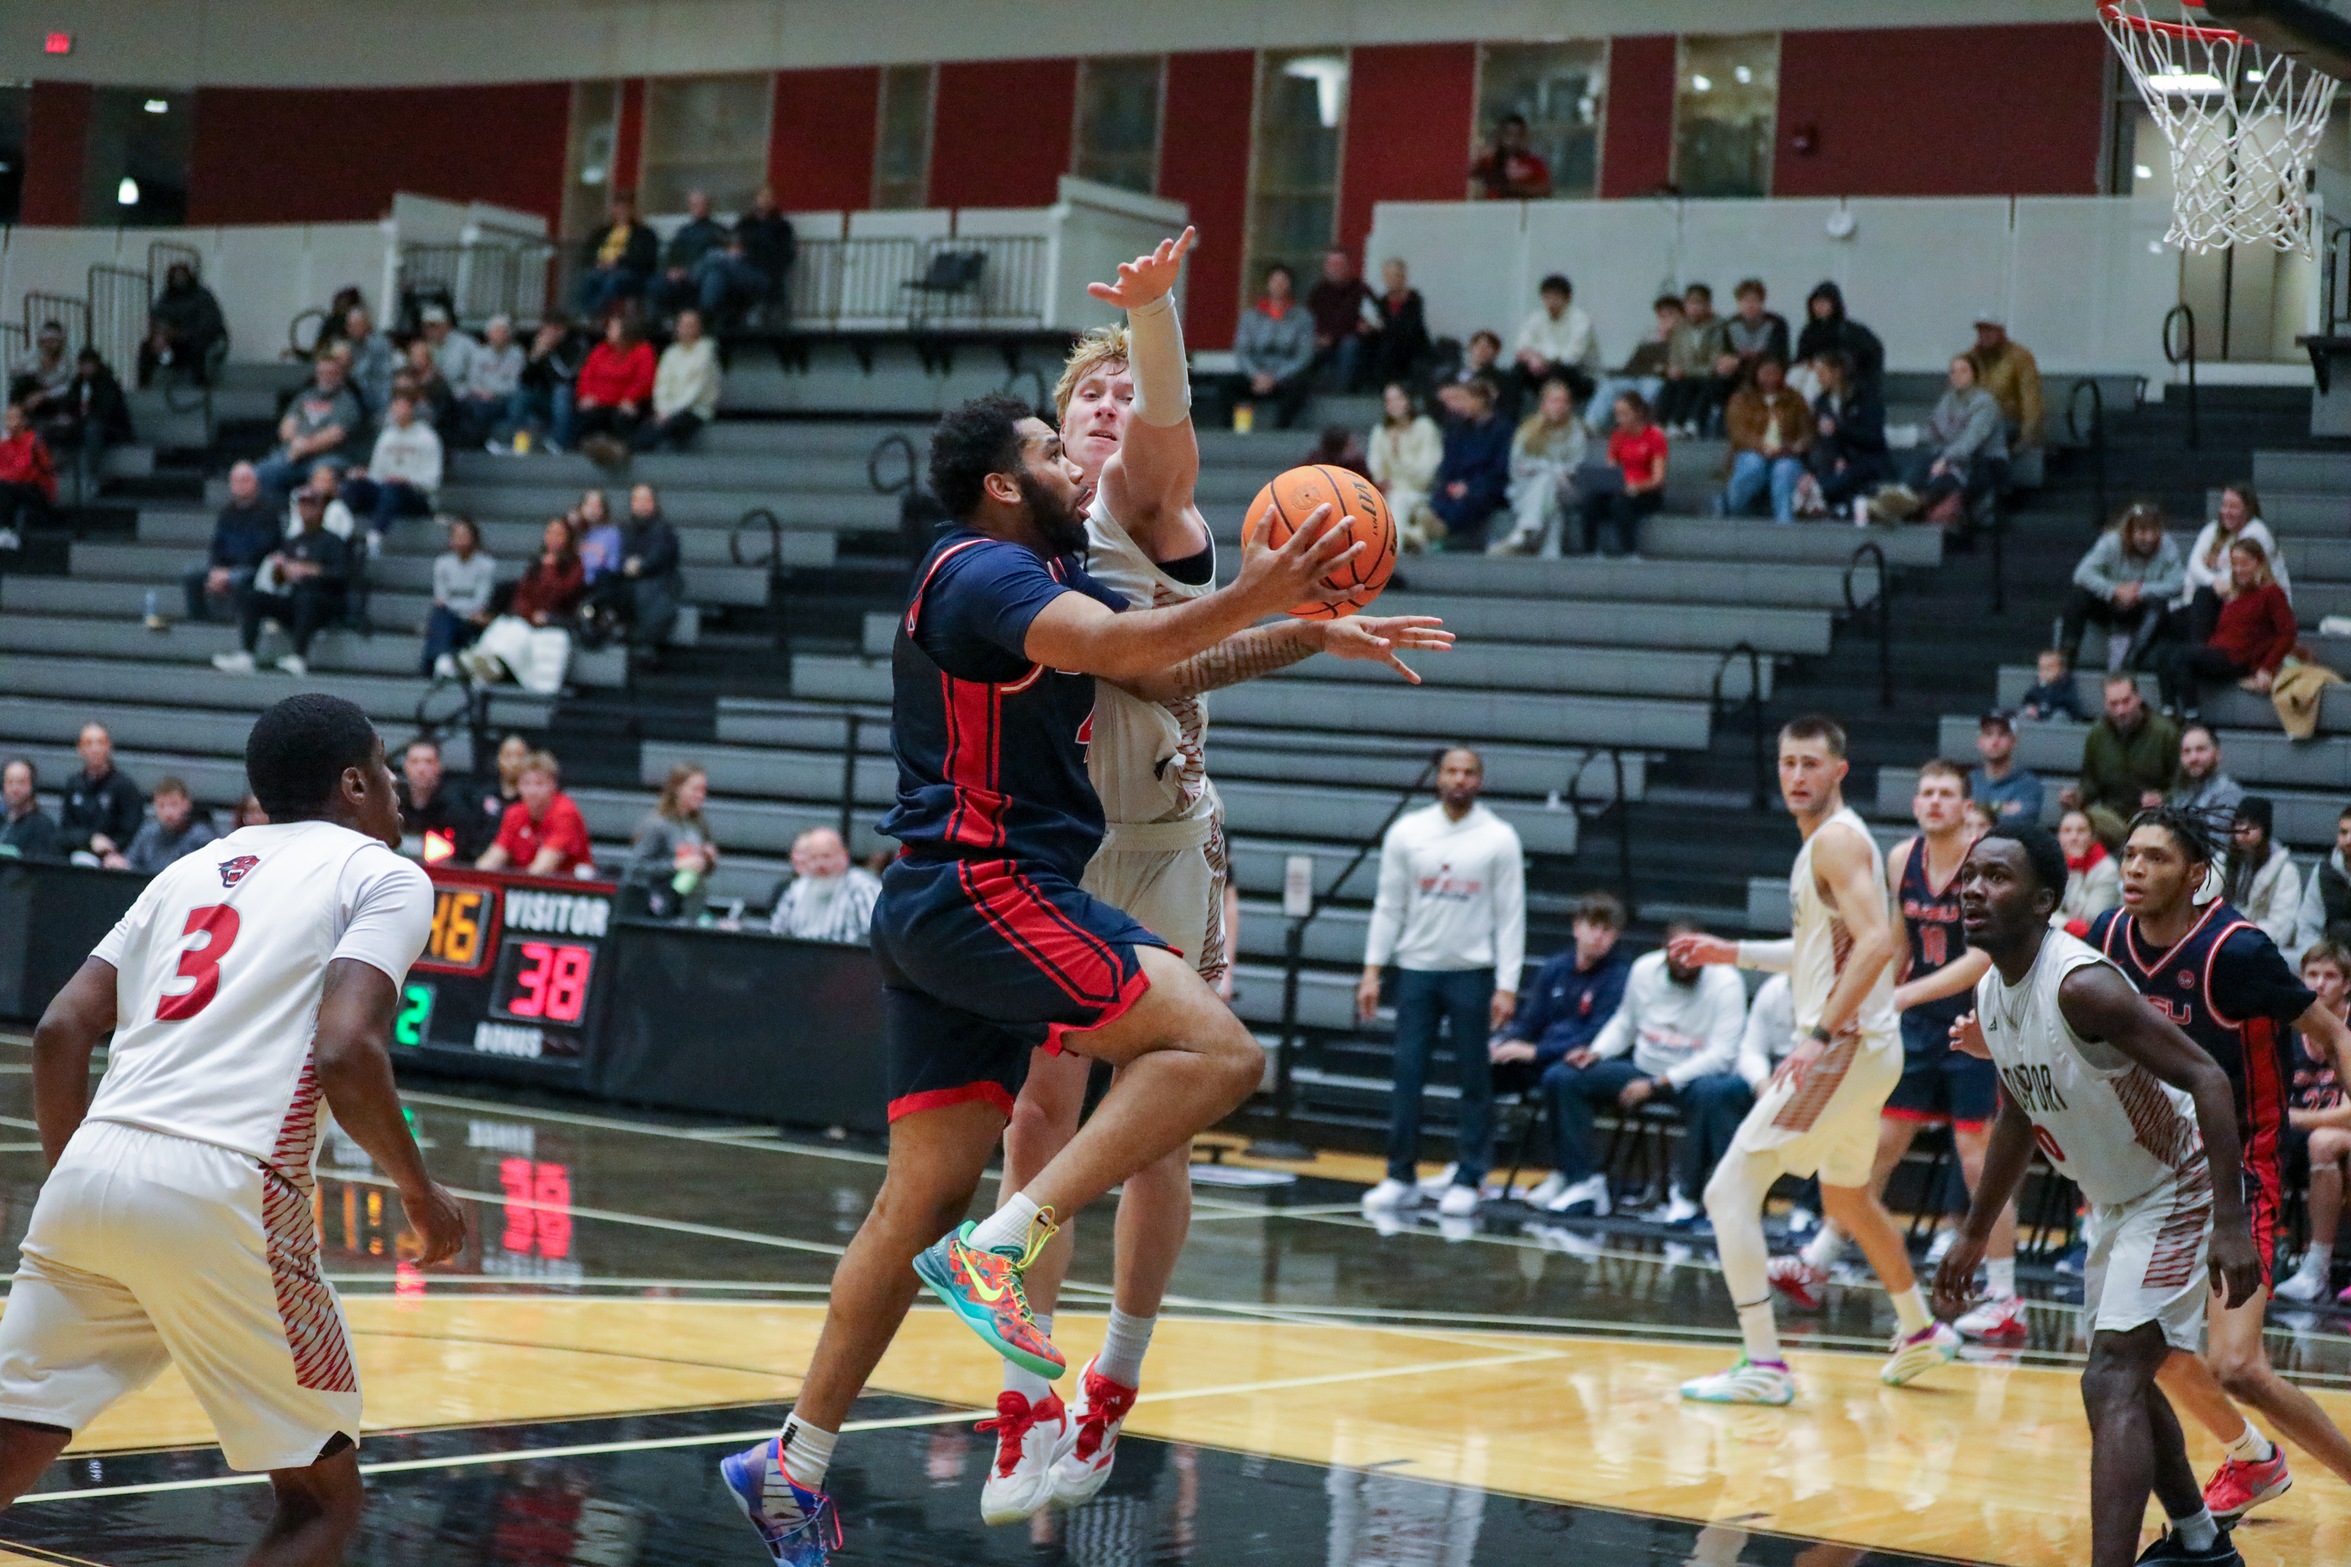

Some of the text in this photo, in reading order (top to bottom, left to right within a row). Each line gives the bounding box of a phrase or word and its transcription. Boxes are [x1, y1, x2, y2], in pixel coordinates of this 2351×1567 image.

[504, 889, 610, 937] VISITOR
[154, 902, 242, 1025] 3
[508, 940, 592, 1022] 38
[395, 984, 432, 1046] 2
